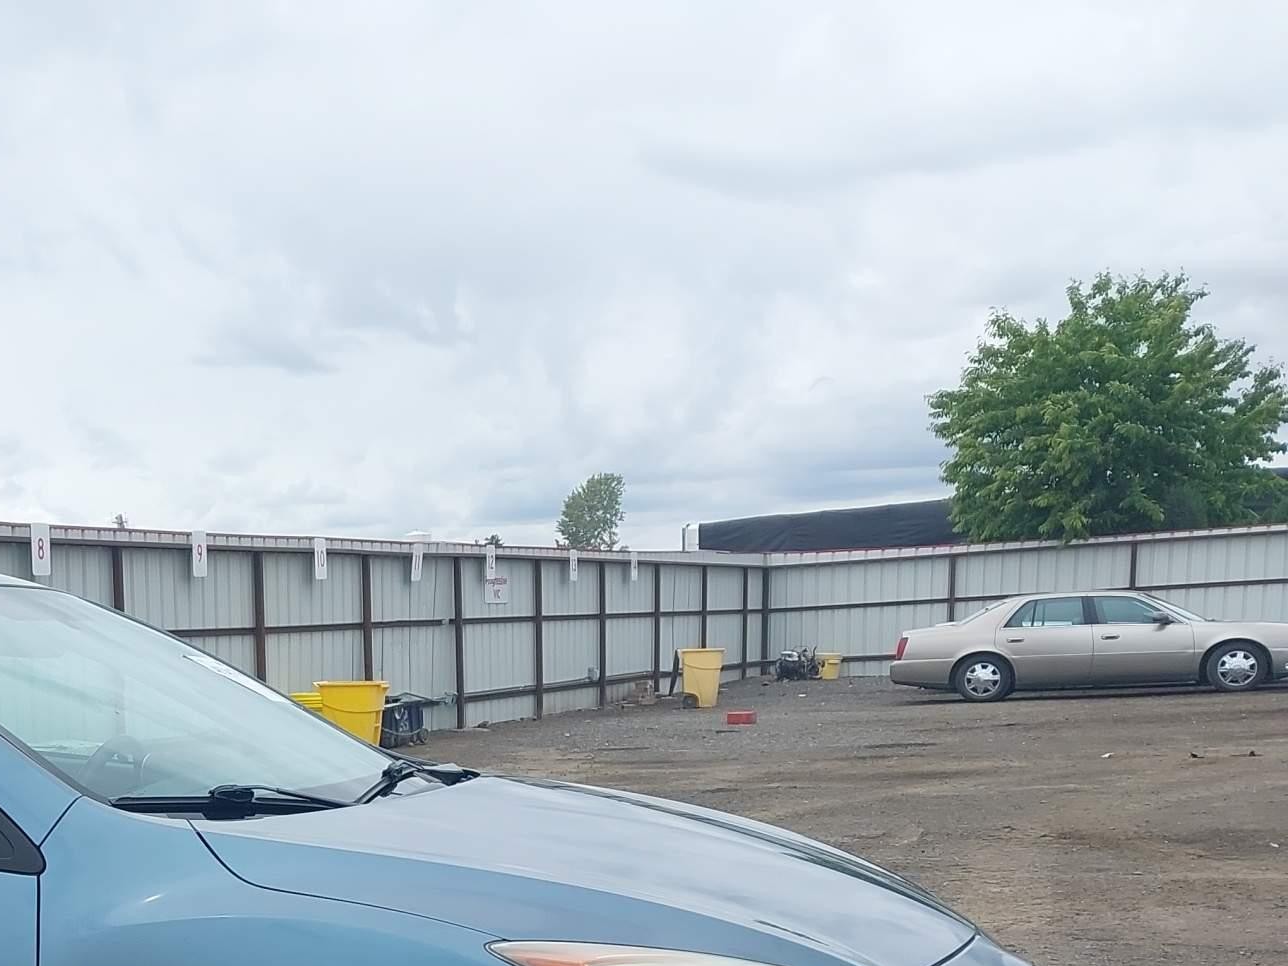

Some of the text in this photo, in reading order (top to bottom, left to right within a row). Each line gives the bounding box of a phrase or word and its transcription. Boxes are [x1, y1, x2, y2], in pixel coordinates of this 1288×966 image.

[37, 537, 45, 560] 8
[197, 543, 203, 563] 9
[316, 550, 325, 568] 10
[413, 554, 420, 572] 11
